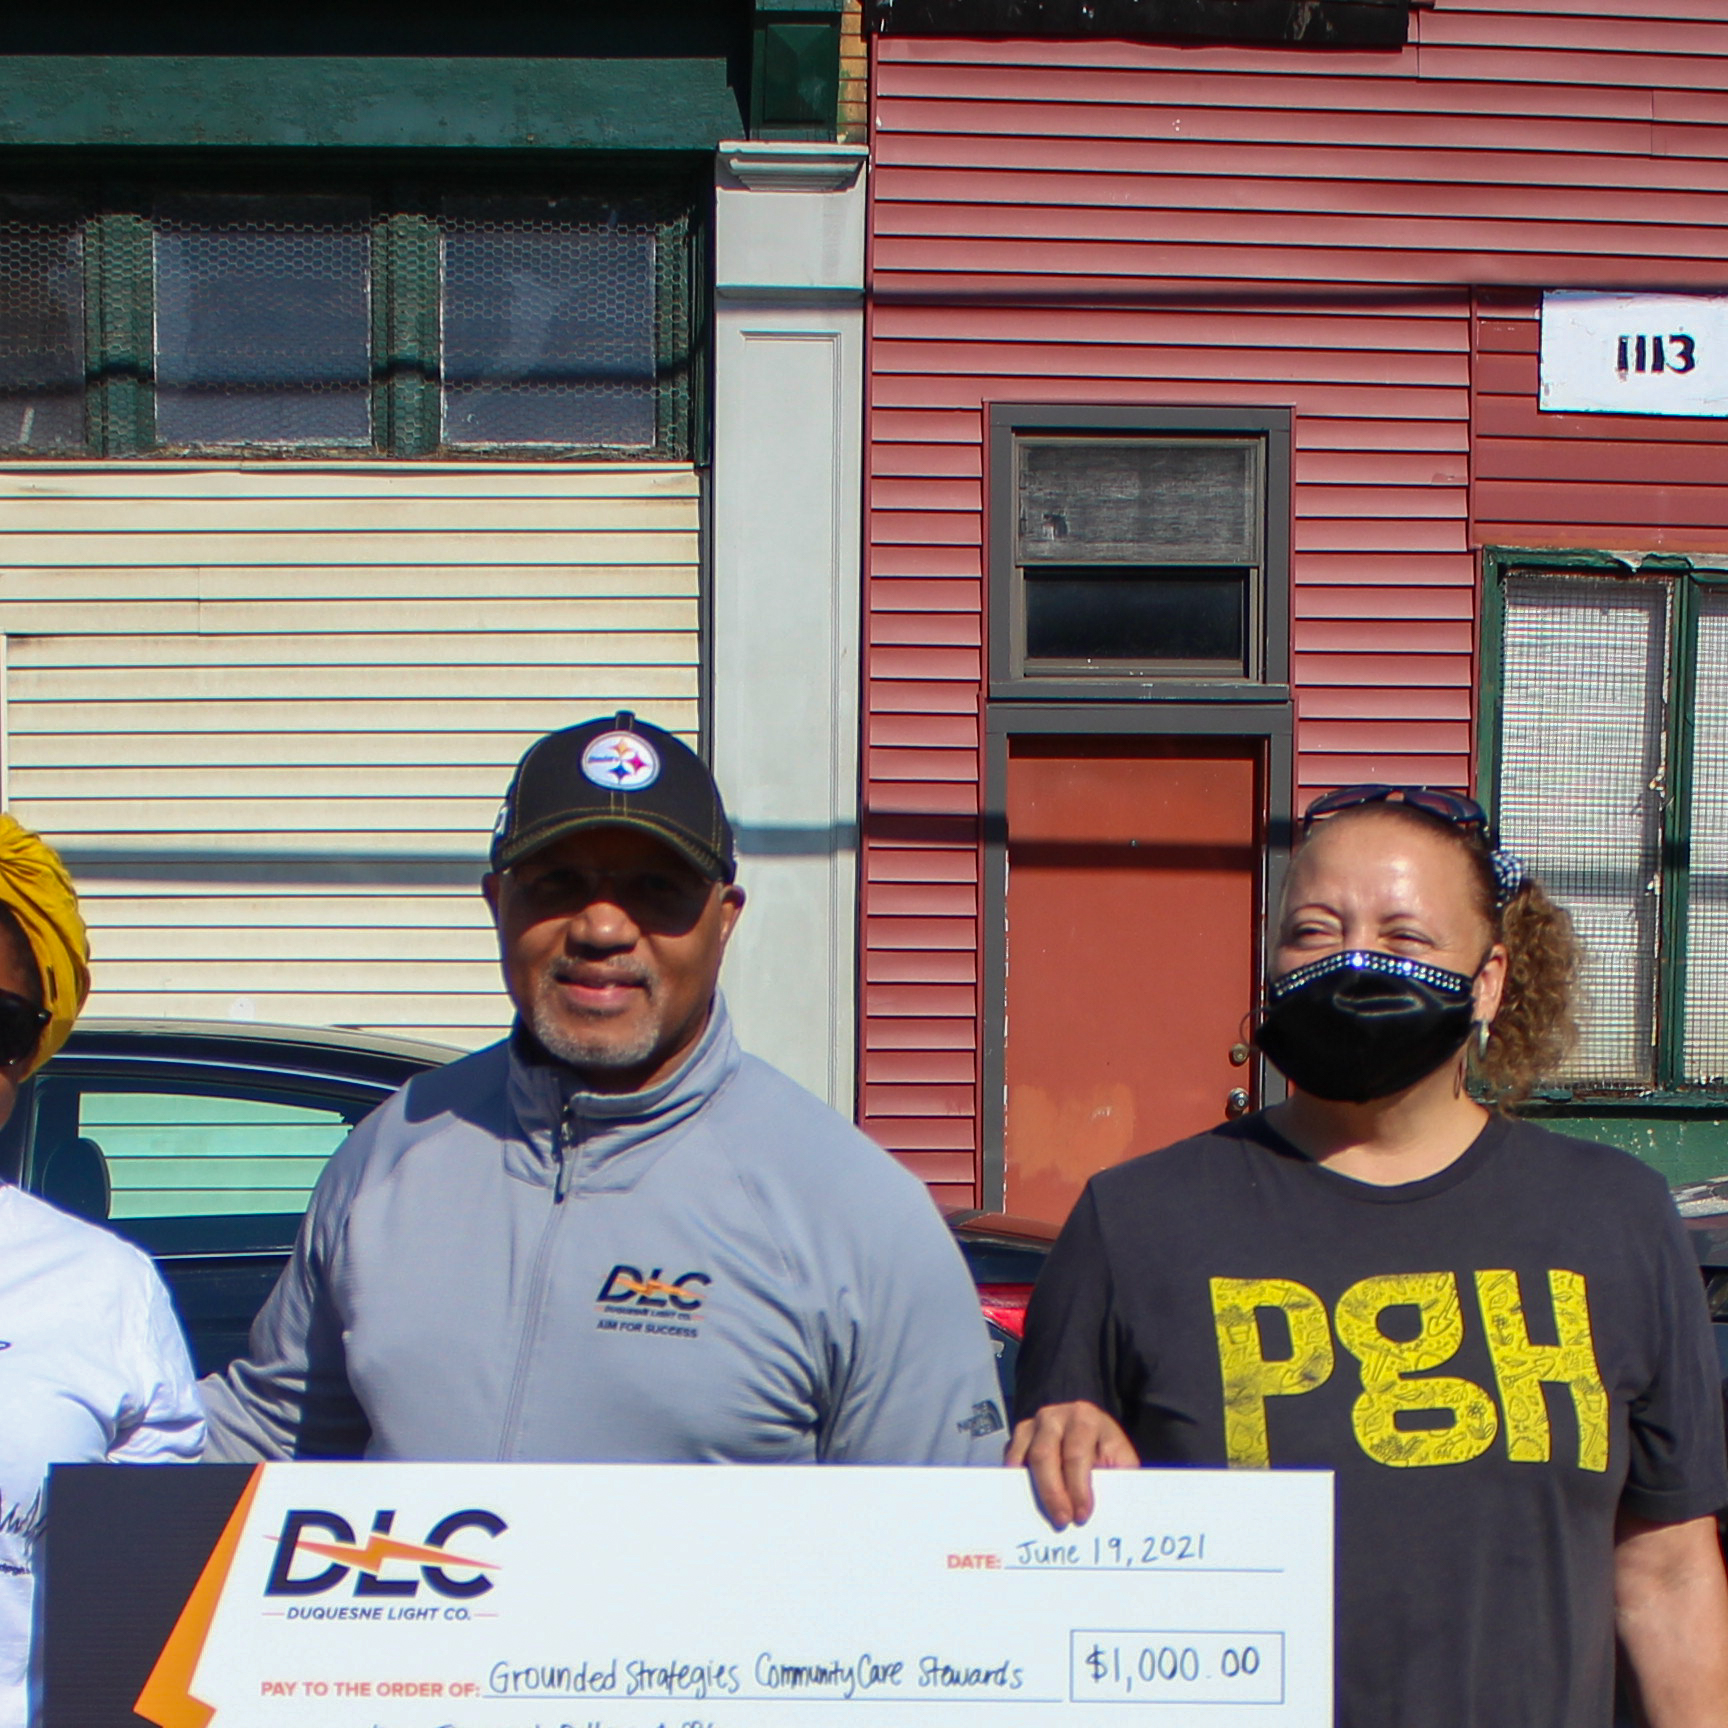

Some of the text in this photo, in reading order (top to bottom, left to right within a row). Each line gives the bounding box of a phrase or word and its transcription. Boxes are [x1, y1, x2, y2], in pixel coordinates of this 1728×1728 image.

[1617, 332, 1695, 374] 1113
[597, 1265, 712, 1310] DLC
[597, 1319, 699, 1338] AIM FOR SUCCESS
[263, 1509, 508, 1599] DLC
[947, 1553, 1001, 1569] DATE:
[1016, 1539, 1080, 1565] June
[286, 1606, 471, 1621] DUQUESNE LIGHT CO.
[261, 1681, 481, 1697] PAY TO THE ORDER OF:
[489, 1658, 617, 1694] Grounded
[625, 1659, 740, 1699] Strategies
[918, 1655, 1024, 1690] Stewards
